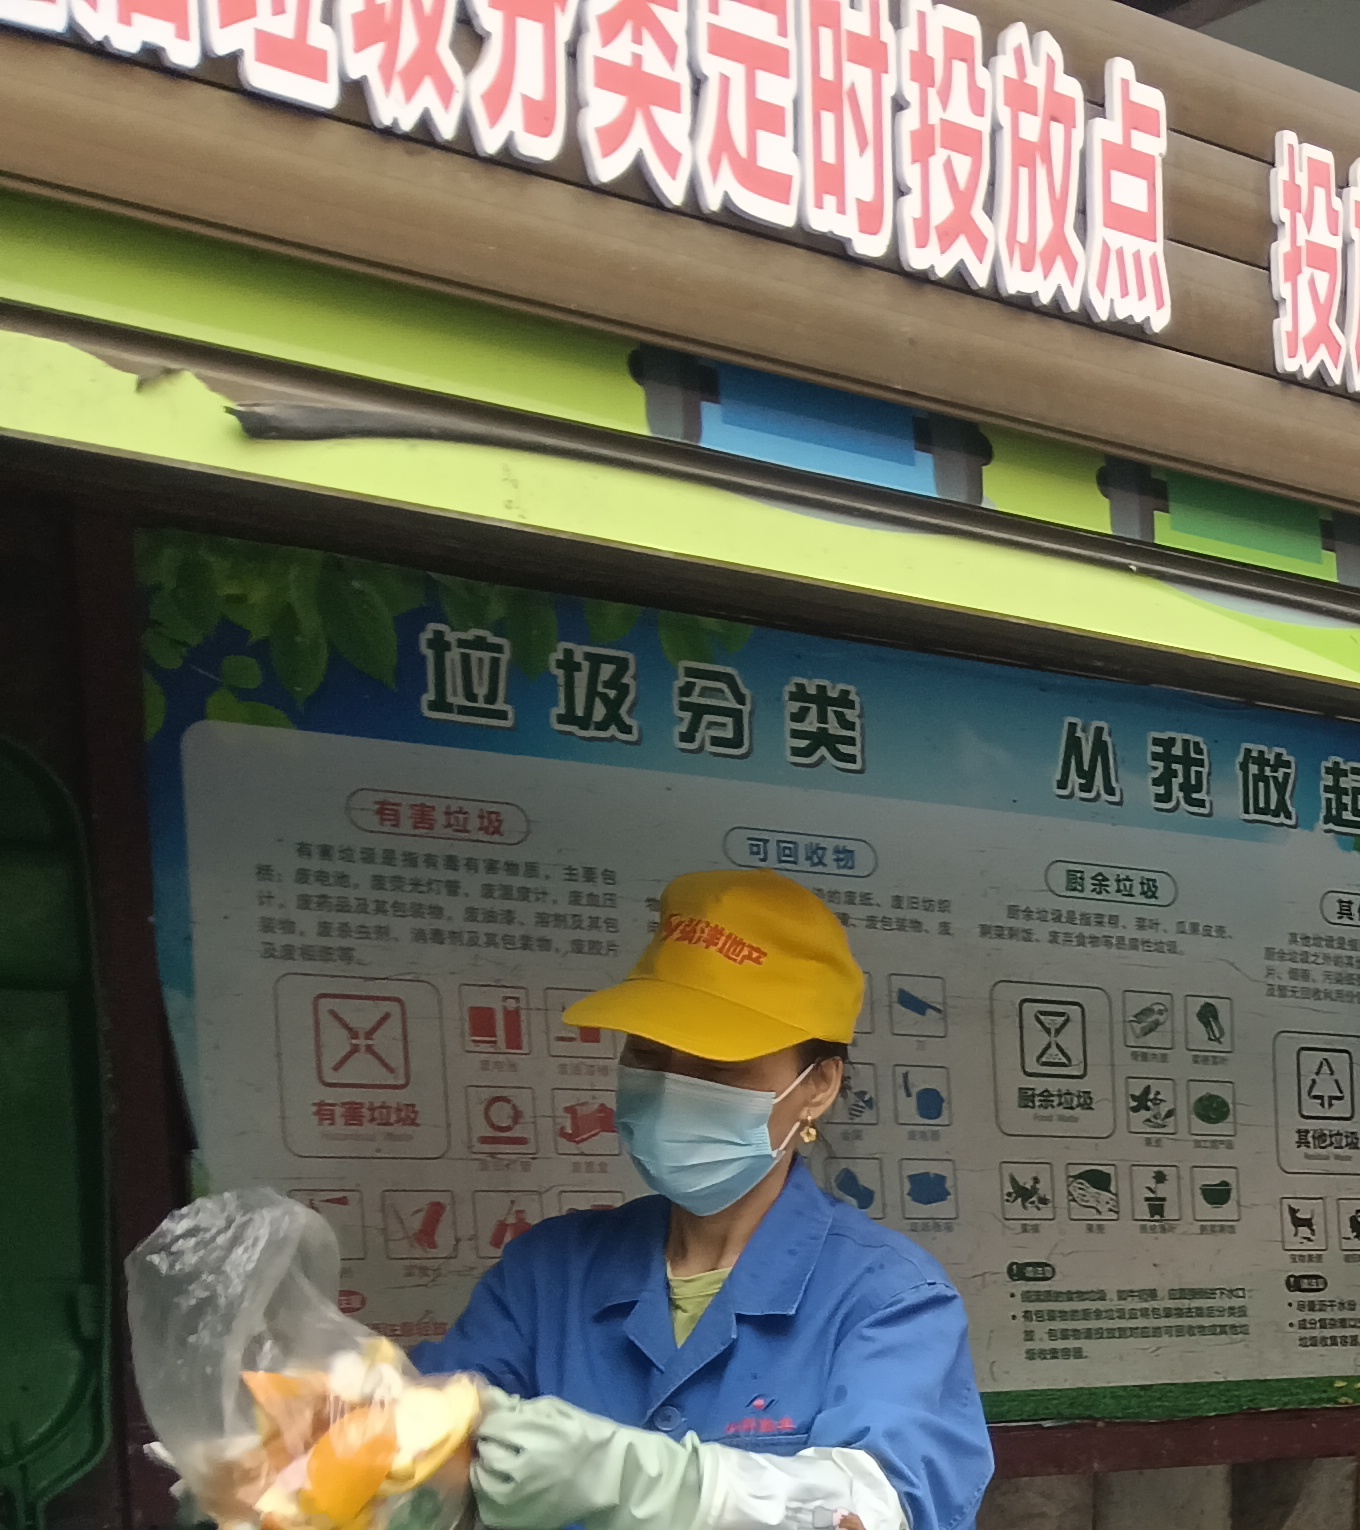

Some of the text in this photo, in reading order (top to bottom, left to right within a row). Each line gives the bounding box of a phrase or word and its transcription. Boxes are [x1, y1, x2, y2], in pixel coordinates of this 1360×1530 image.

[0, 0, 1172, 334] 分类定时投放点
[418, 621, 864, 772] 垃圾分类
[373, 799, 505, 837] 有害垃圾
[745, 835, 857, 871] 可回收物
[1064, 868, 1160, 900] 厨余垃圾
[311, 1099, 421, 1128] 有害垃圾
[1017, 1086, 1096, 1111] 厨余垃圾
